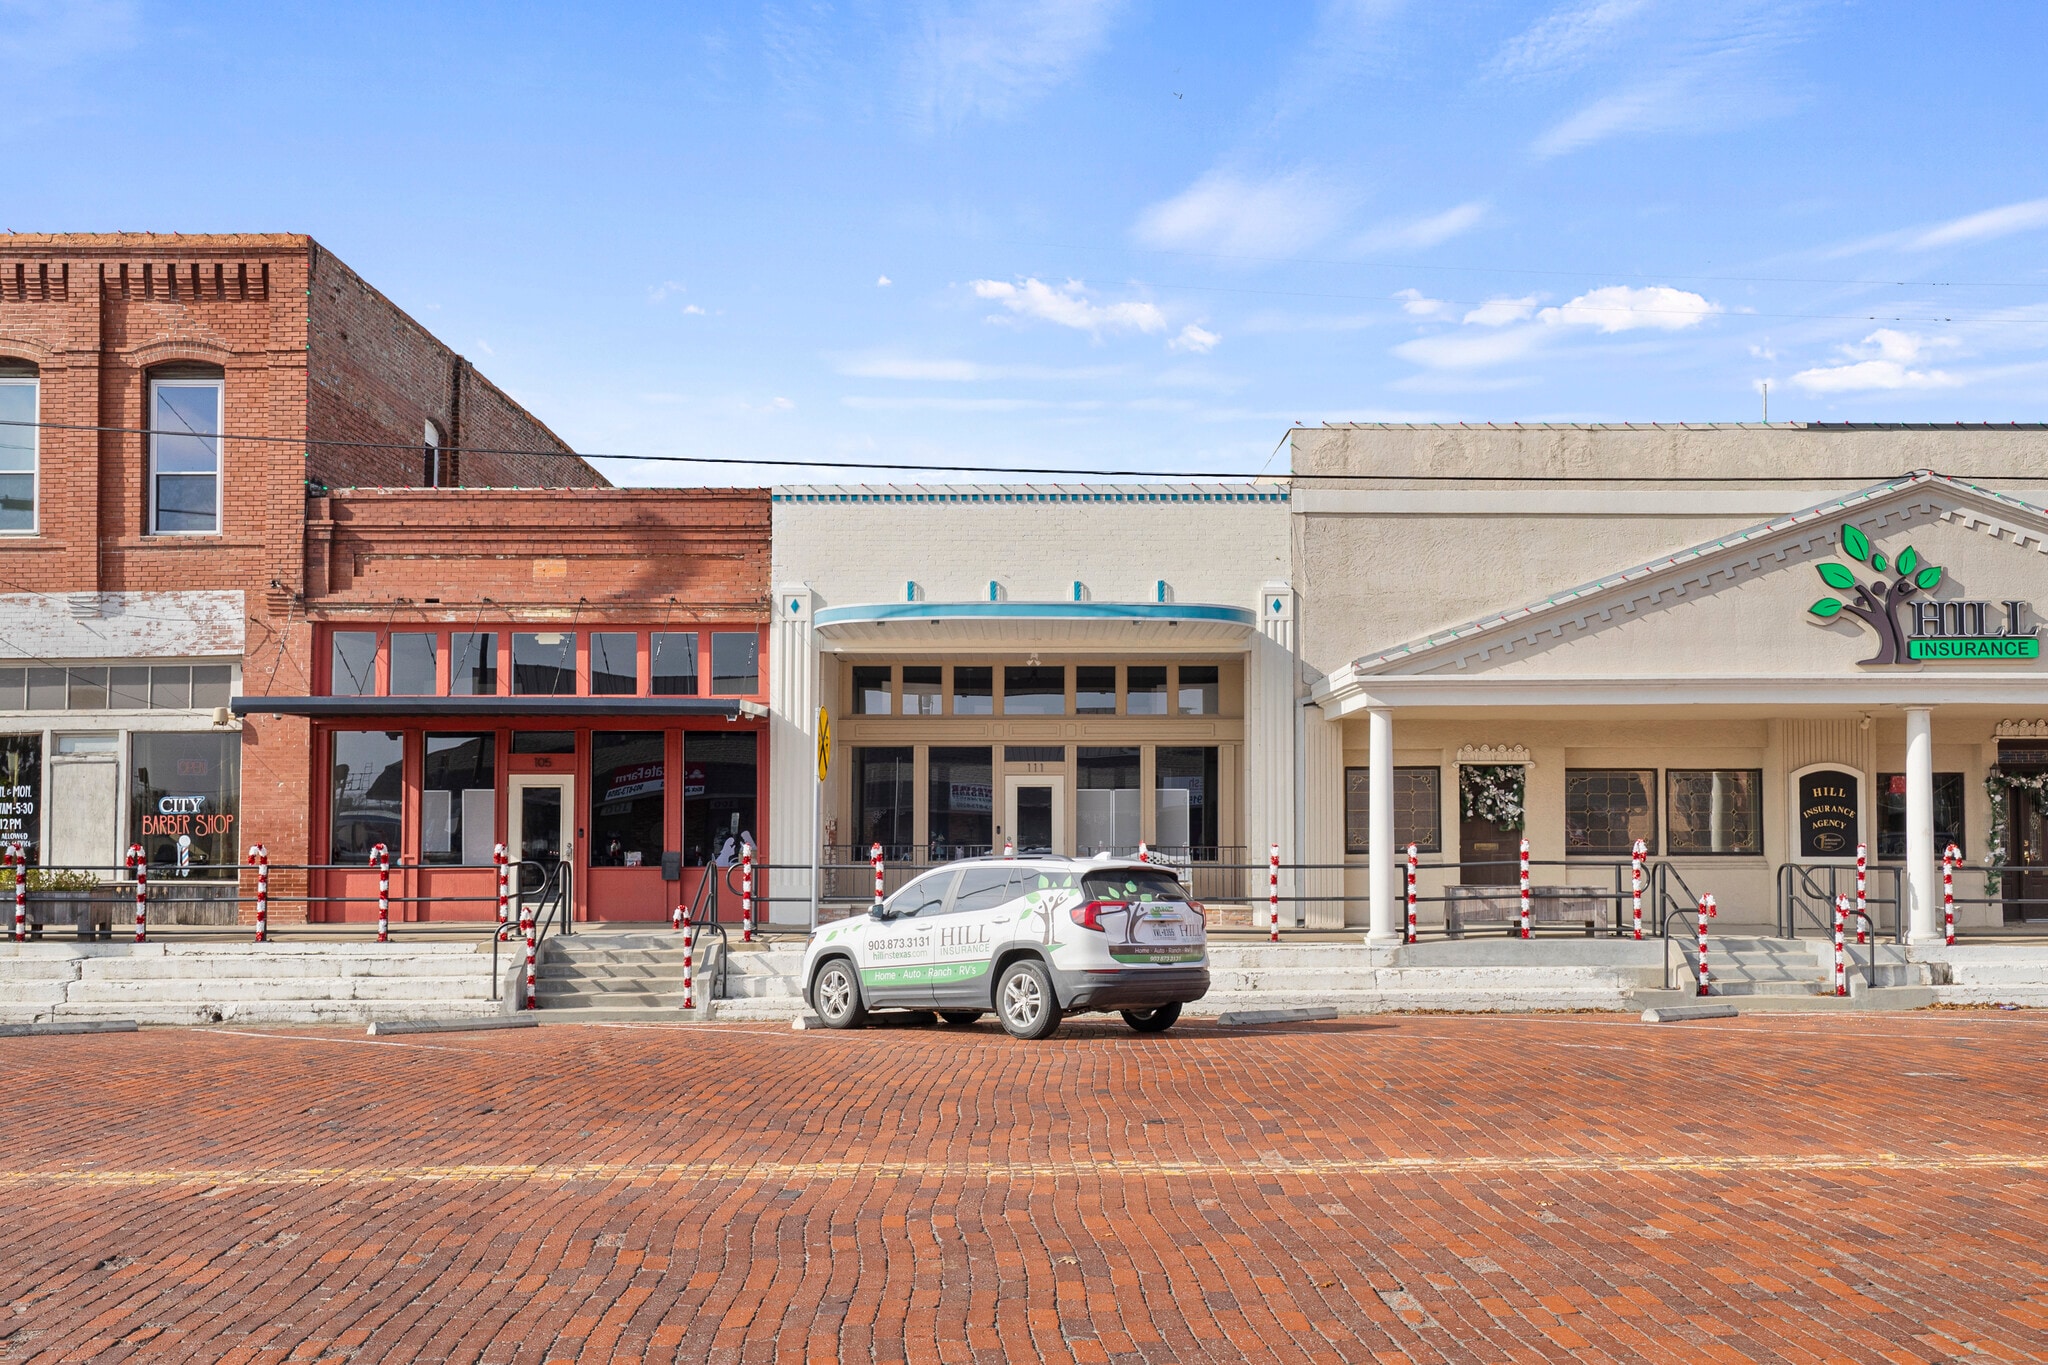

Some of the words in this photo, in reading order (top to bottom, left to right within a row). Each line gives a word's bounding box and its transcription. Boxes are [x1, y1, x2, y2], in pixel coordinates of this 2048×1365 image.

[1907, 601, 2039, 638] HILL
[1919, 641, 2029, 656] INSURANCE
[534, 757, 552, 768] 105
[1027, 762, 1044, 773] 111
[1812, 787, 1846, 797] HILL
[160, 796, 204, 813] CITY
[1803, 805, 1856, 819] INSURANCE
[142, 814, 190, 835] BARBER
[195, 814, 234, 837] SHOP
[1812, 819, 1847, 829] AGENCY
[1, 832, 28, 840] ALLOWED
[941, 924, 991, 946] HILL
[1178, 924, 1201, 937] HILL
[868, 936, 930, 950] 903.873.3131
[940, 943, 990, 956] INSURANCE
[873, 950, 928, 960] hillinstexas.com
[874, 971, 896, 980] Home
[903, 969, 921, 979] Auto
[928, 967, 952, 977] Ranch
[959, 965, 977, 975] RV's
